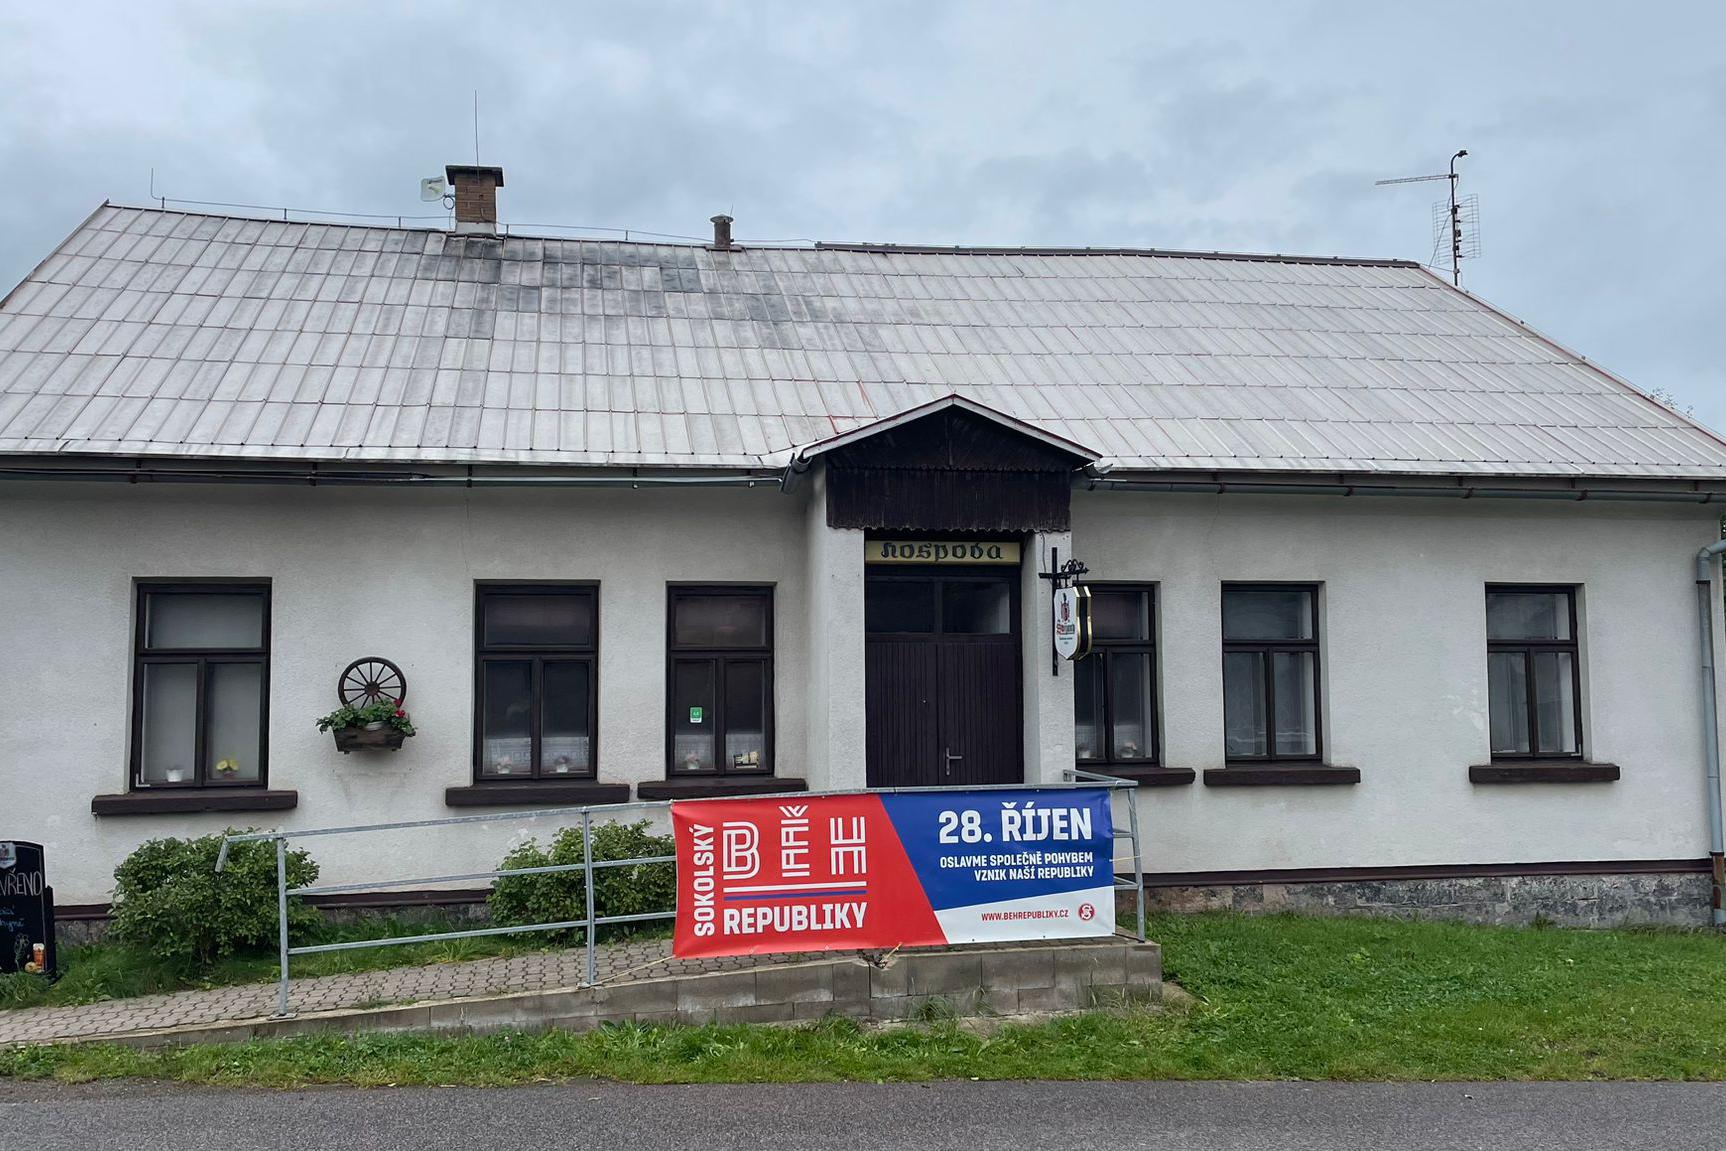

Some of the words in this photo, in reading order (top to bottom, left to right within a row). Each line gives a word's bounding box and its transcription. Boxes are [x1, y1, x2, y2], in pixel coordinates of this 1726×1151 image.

[938, 810, 992, 844] 28.
[1001, 801, 1092, 842] ŘÍJEN
[940, 855, 987, 868] OSLAVME
[990, 851, 1042, 866] SPOLEČNĚ
[1045, 852, 1093, 865] POHYBEM
[689, 824, 715, 937] SOKOLSKÝ
[974, 868, 1007, 881] VZNIK
[1009, 866, 1035, 880] NAŠÍ
[1038, 866, 1094, 879] REPUBLIKY
[723, 902, 867, 936] REPUBLIKY
[981, 909, 1069, 921] WWW.BEHREPUBLIKY.CZ
